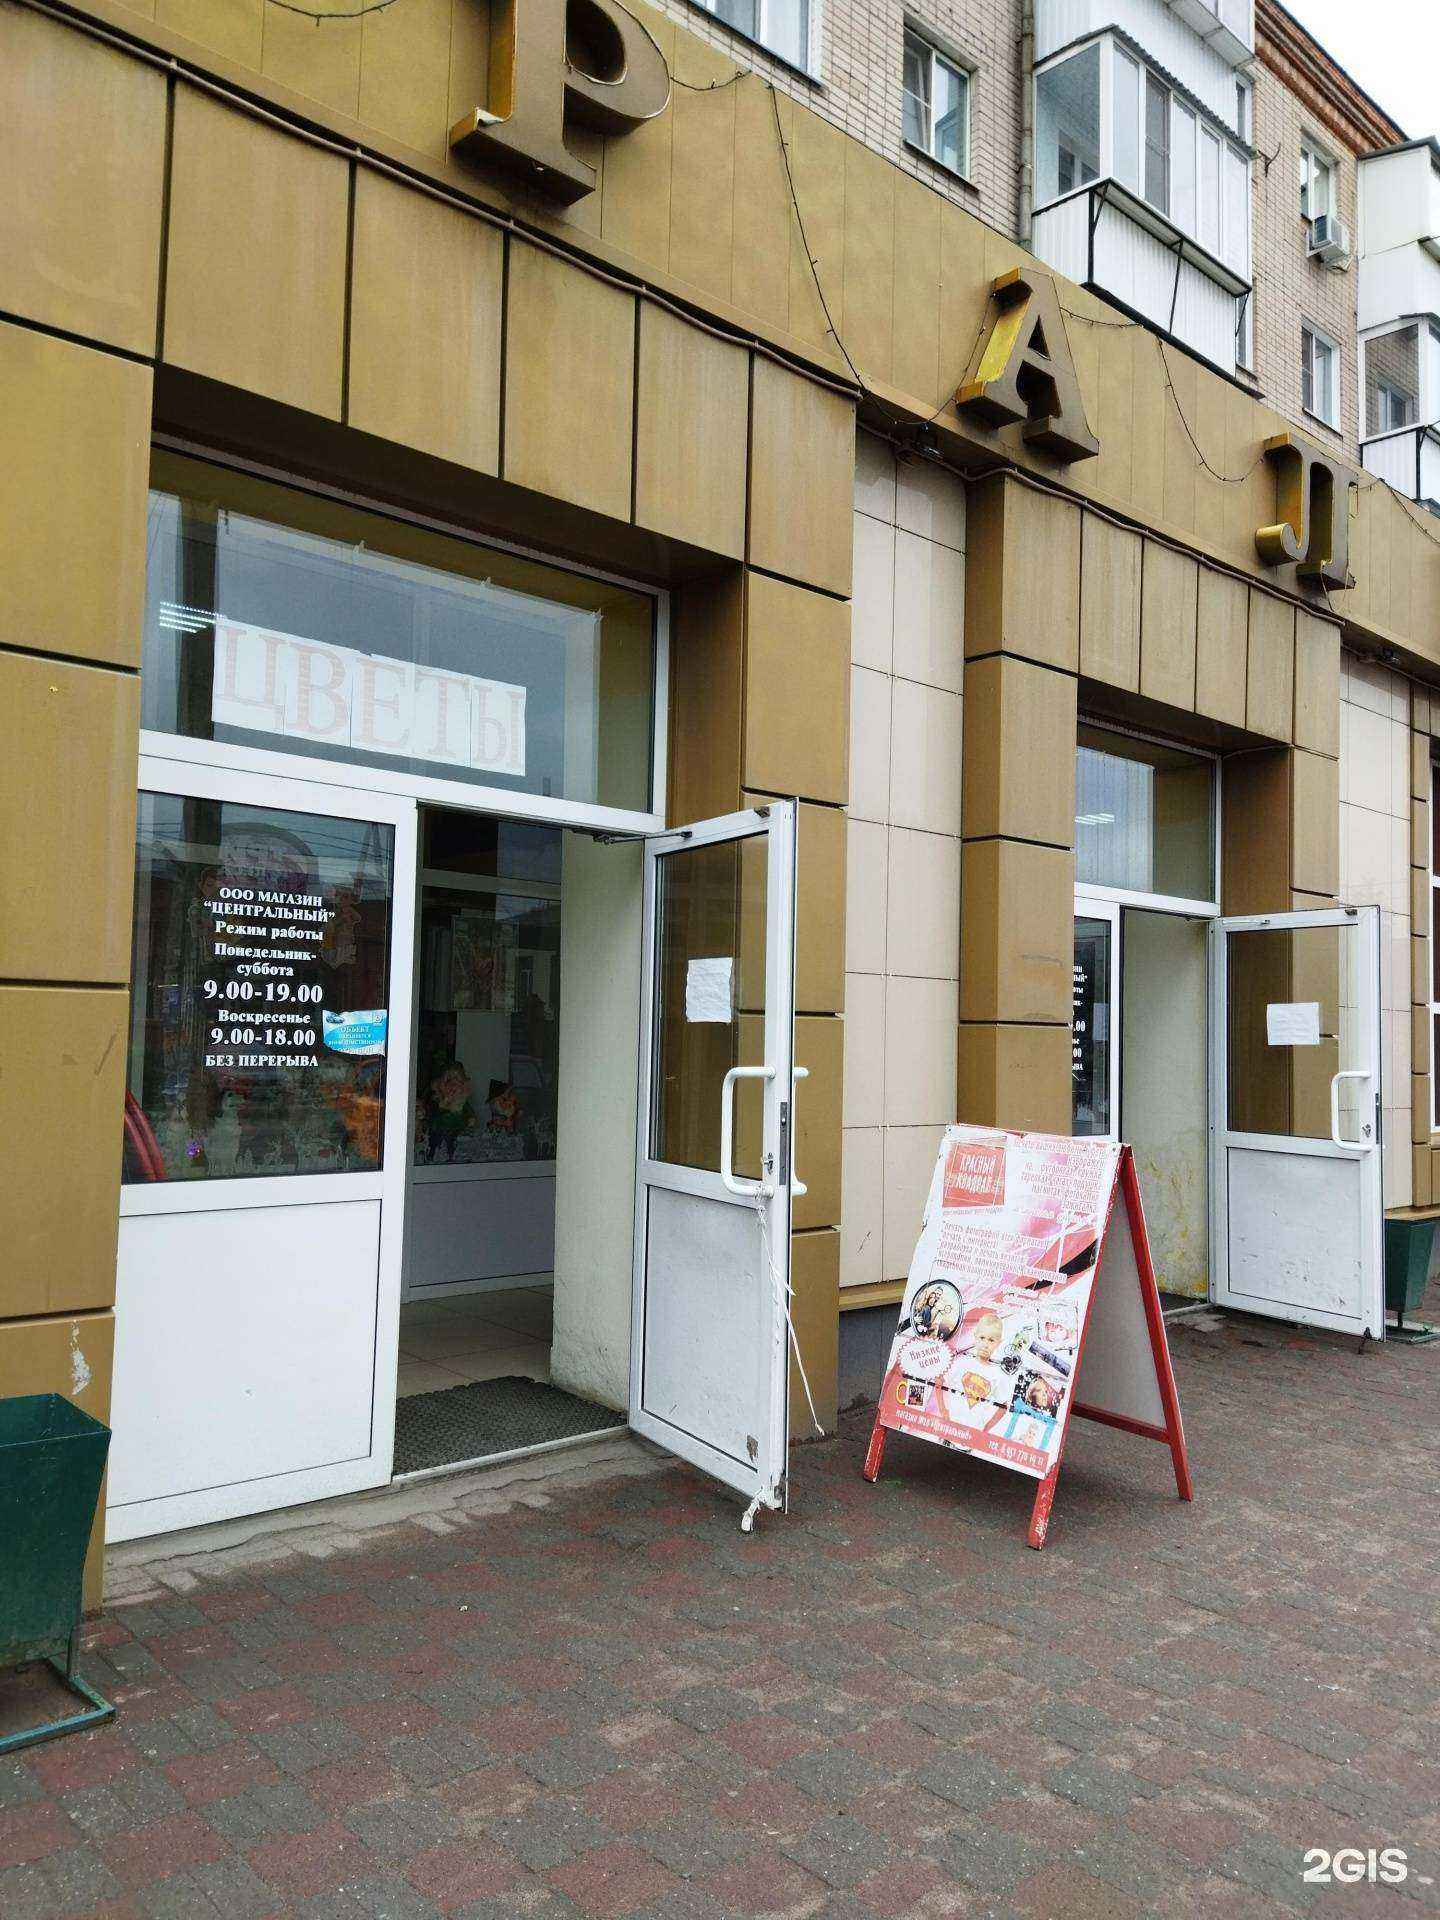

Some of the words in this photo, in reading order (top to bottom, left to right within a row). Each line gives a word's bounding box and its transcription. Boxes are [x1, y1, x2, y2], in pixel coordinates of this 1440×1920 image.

[216, 626, 525, 767] ЦВЕТЫ
[219, 887, 254, 900] ООО
[258, 891, 322, 907] МАГАЗИН
[215, 920, 267, 936] Режим
[271, 926, 324, 941] работы
[214, 942, 317, 961] Понедельник-
[236, 962, 294, 976] суббота
[204, 979, 323, 1003] 9.00-19.00
[218, 1010, 311, 1025] Воскресенье
[210, 1028, 316, 1046] 9.00-18.00
[205, 1055, 234, 1067] БЕЗ
[238, 1055, 319, 1067] ПЕРЕРЫВА
[959, 1153, 997, 1176] КРАСНЫЙ
[956, 1174, 994, 1194] КВАДРАТ
[909, 1343, 941, 1361] Низкие
[918, 1355, 941, 1369] цены
